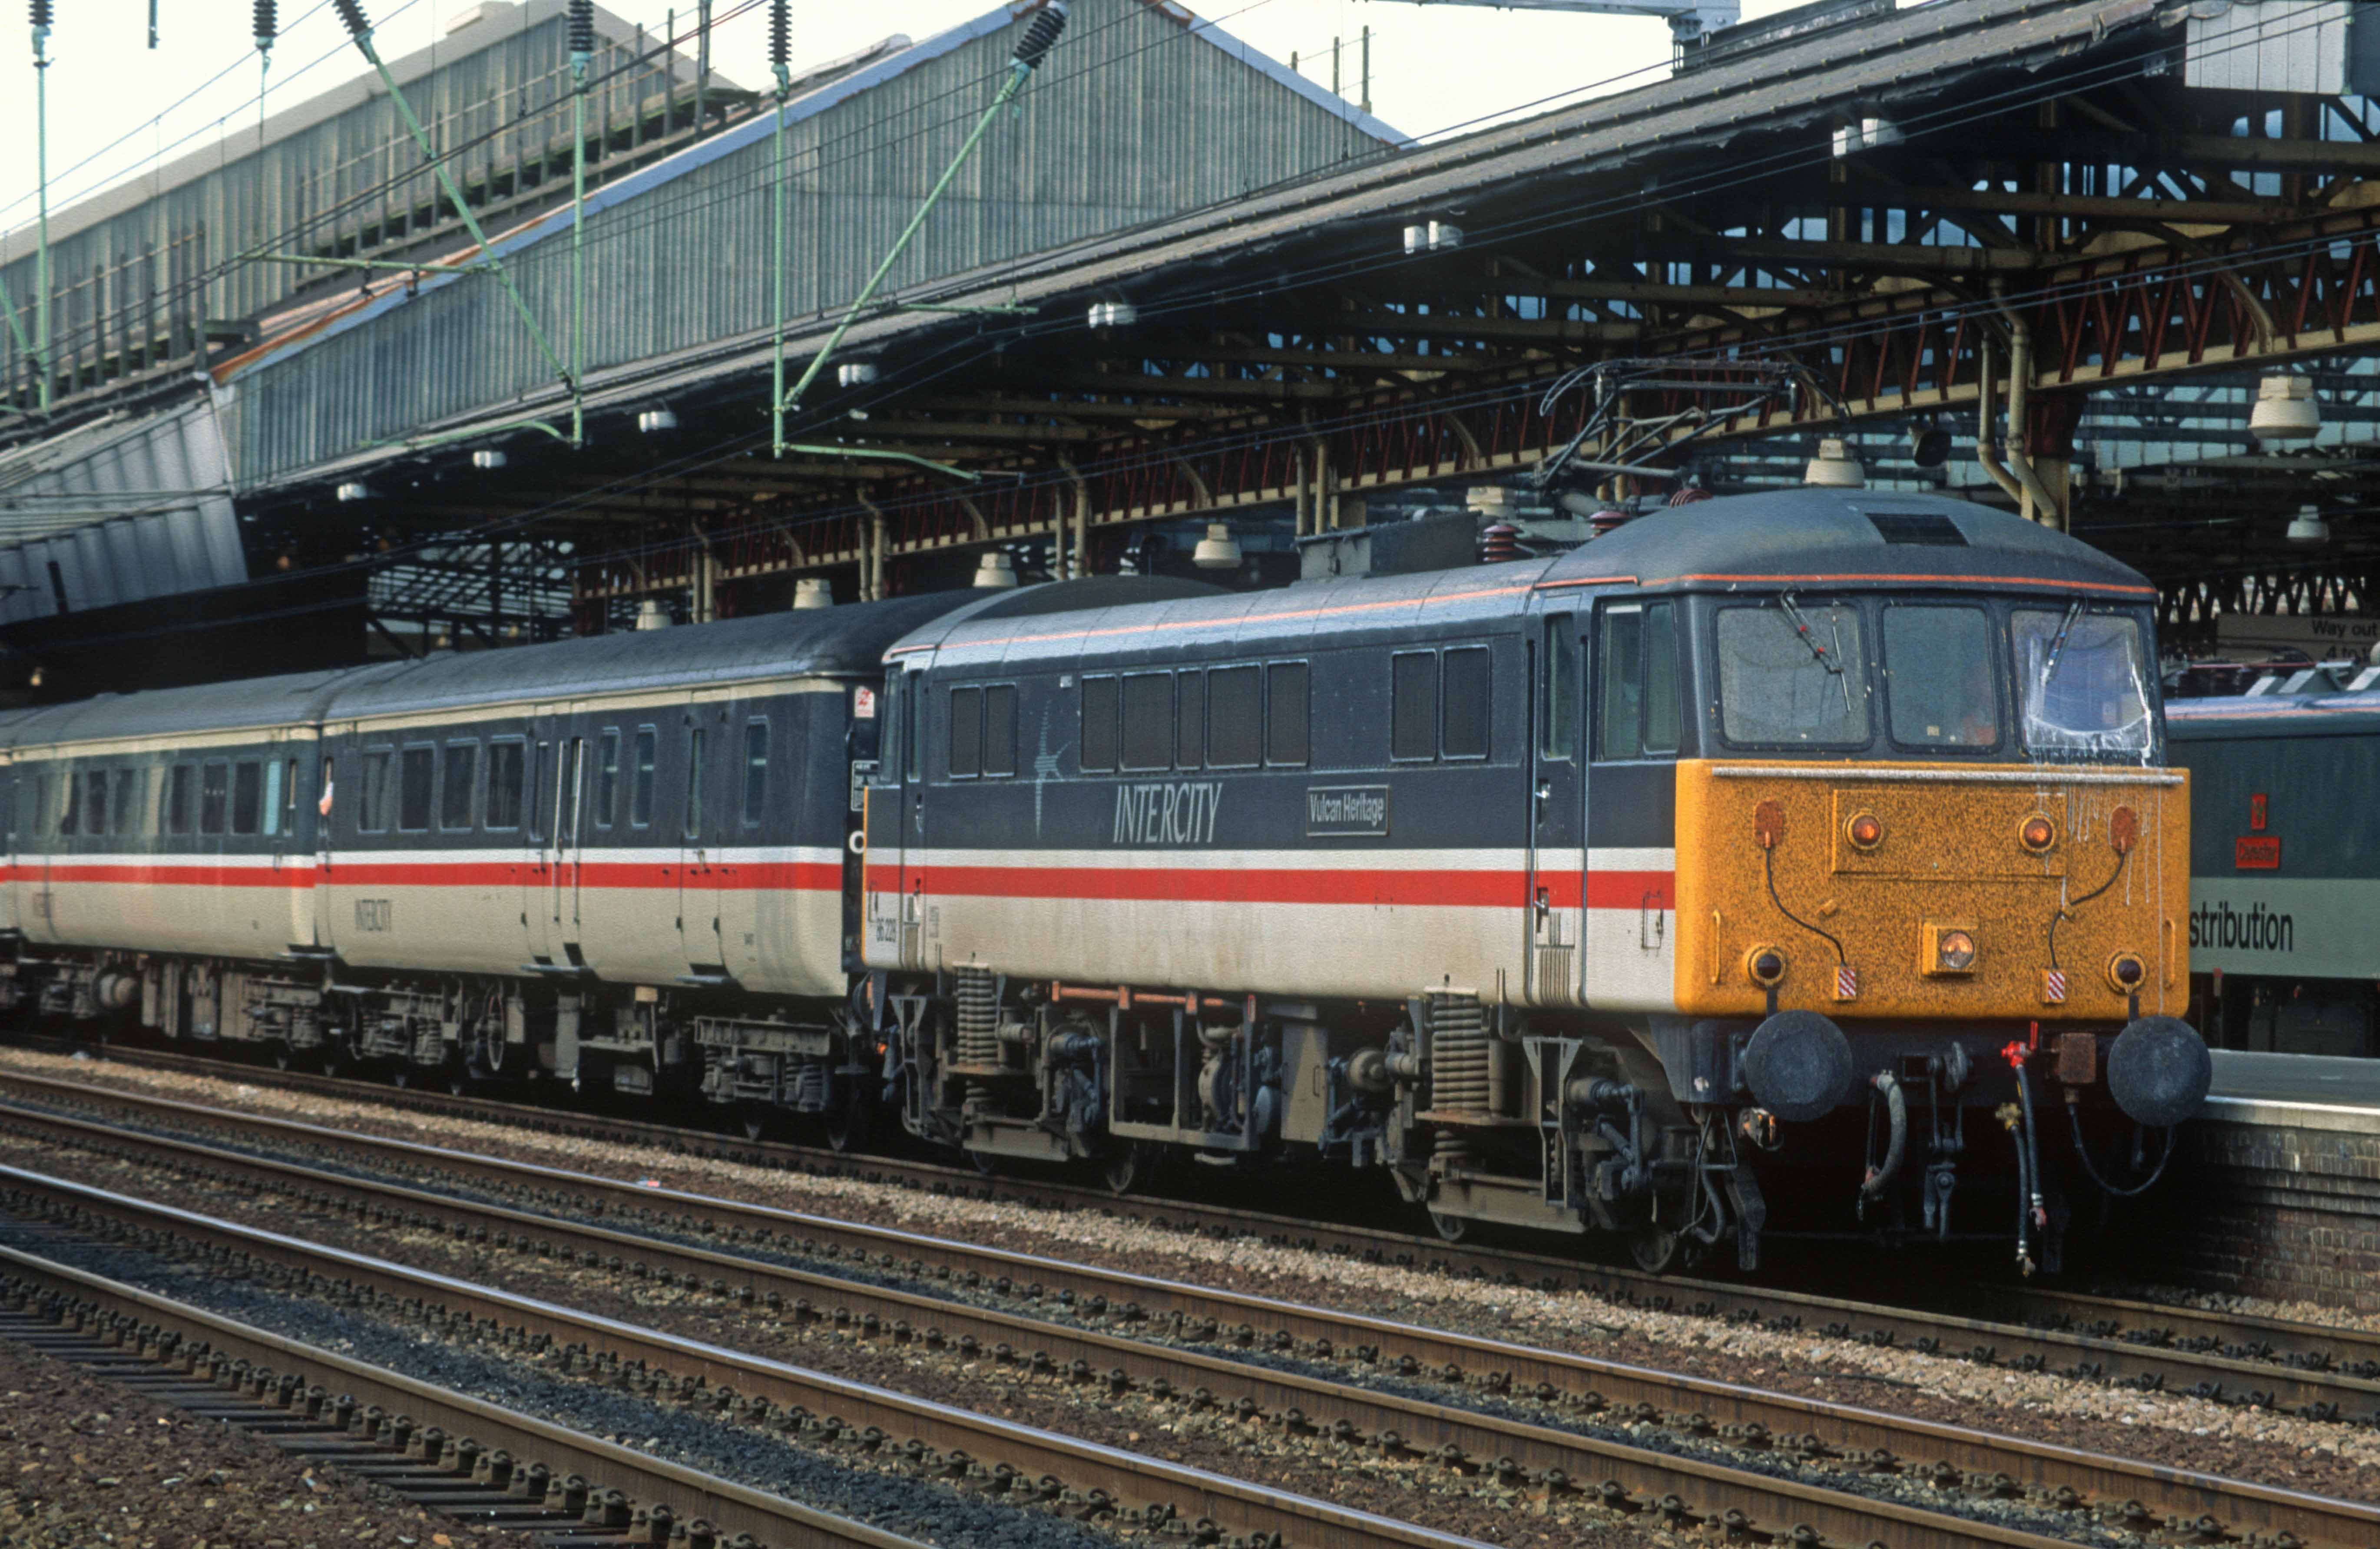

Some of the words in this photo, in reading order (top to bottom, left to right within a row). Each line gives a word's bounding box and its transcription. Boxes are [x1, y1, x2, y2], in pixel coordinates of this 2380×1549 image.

[2312, 620, 2346, 638] Way
[2351, 623, 2377, 637] out
[1113, 783, 1223, 844] INTERCITY
[1310, 793, 1341, 822] Vulcan
[1343, 792, 1384, 827] Heritage
[2189, 901, 2293, 952] stribution
